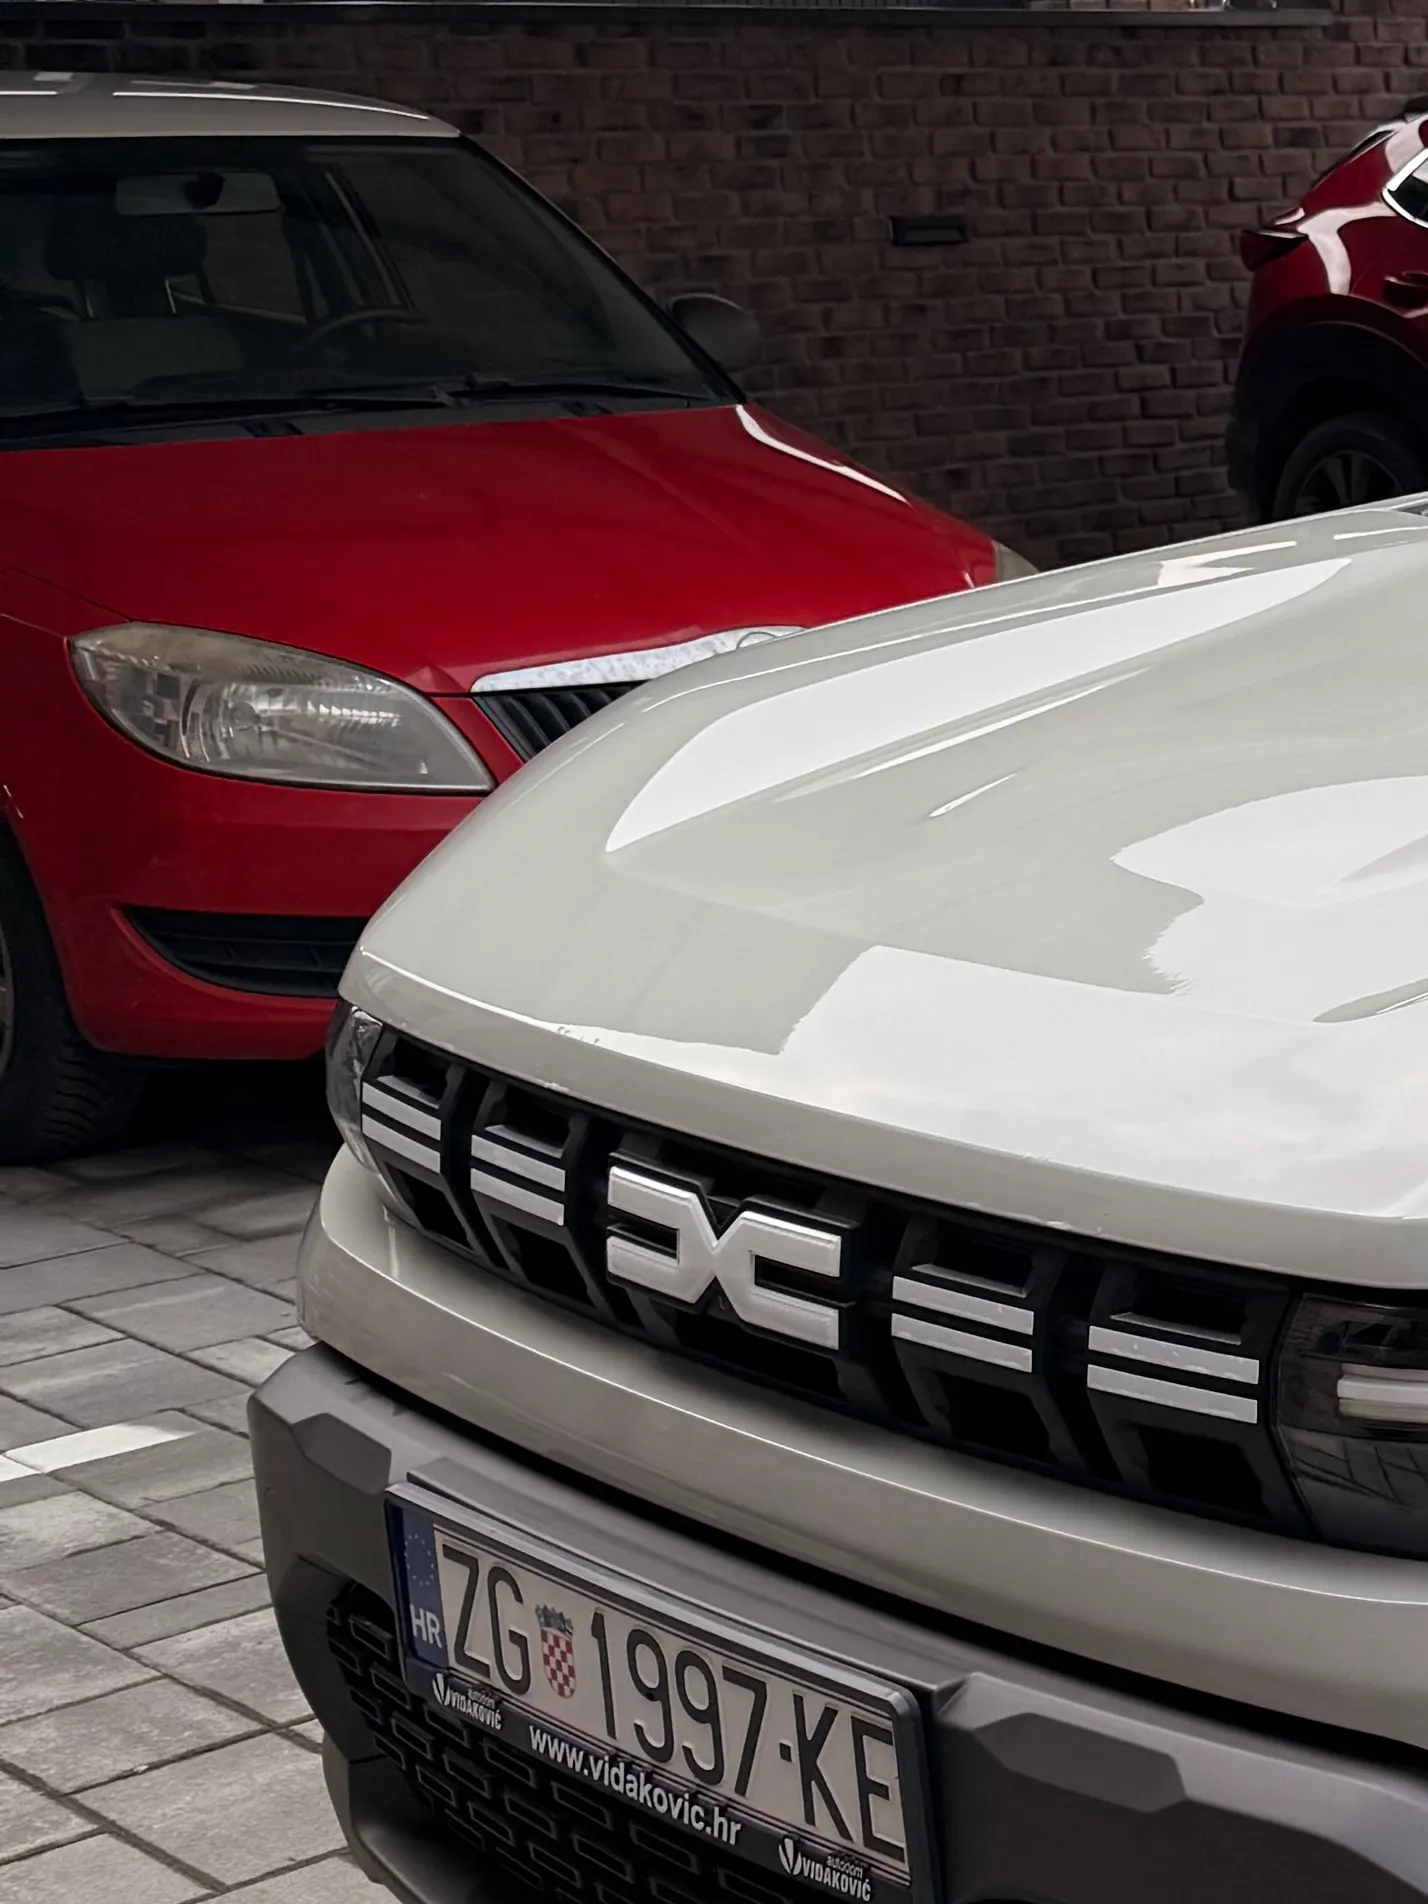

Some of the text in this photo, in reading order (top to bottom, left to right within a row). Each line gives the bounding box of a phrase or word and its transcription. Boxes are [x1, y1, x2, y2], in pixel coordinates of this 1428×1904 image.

[410, 1603, 442, 1649] HR
[442, 1544, 907, 1863] ZG 1997-KE
[529, 1723, 742, 1847] www.vidakovic.hr
[801, 1857, 872, 1902] VIDAKOVIĆ
